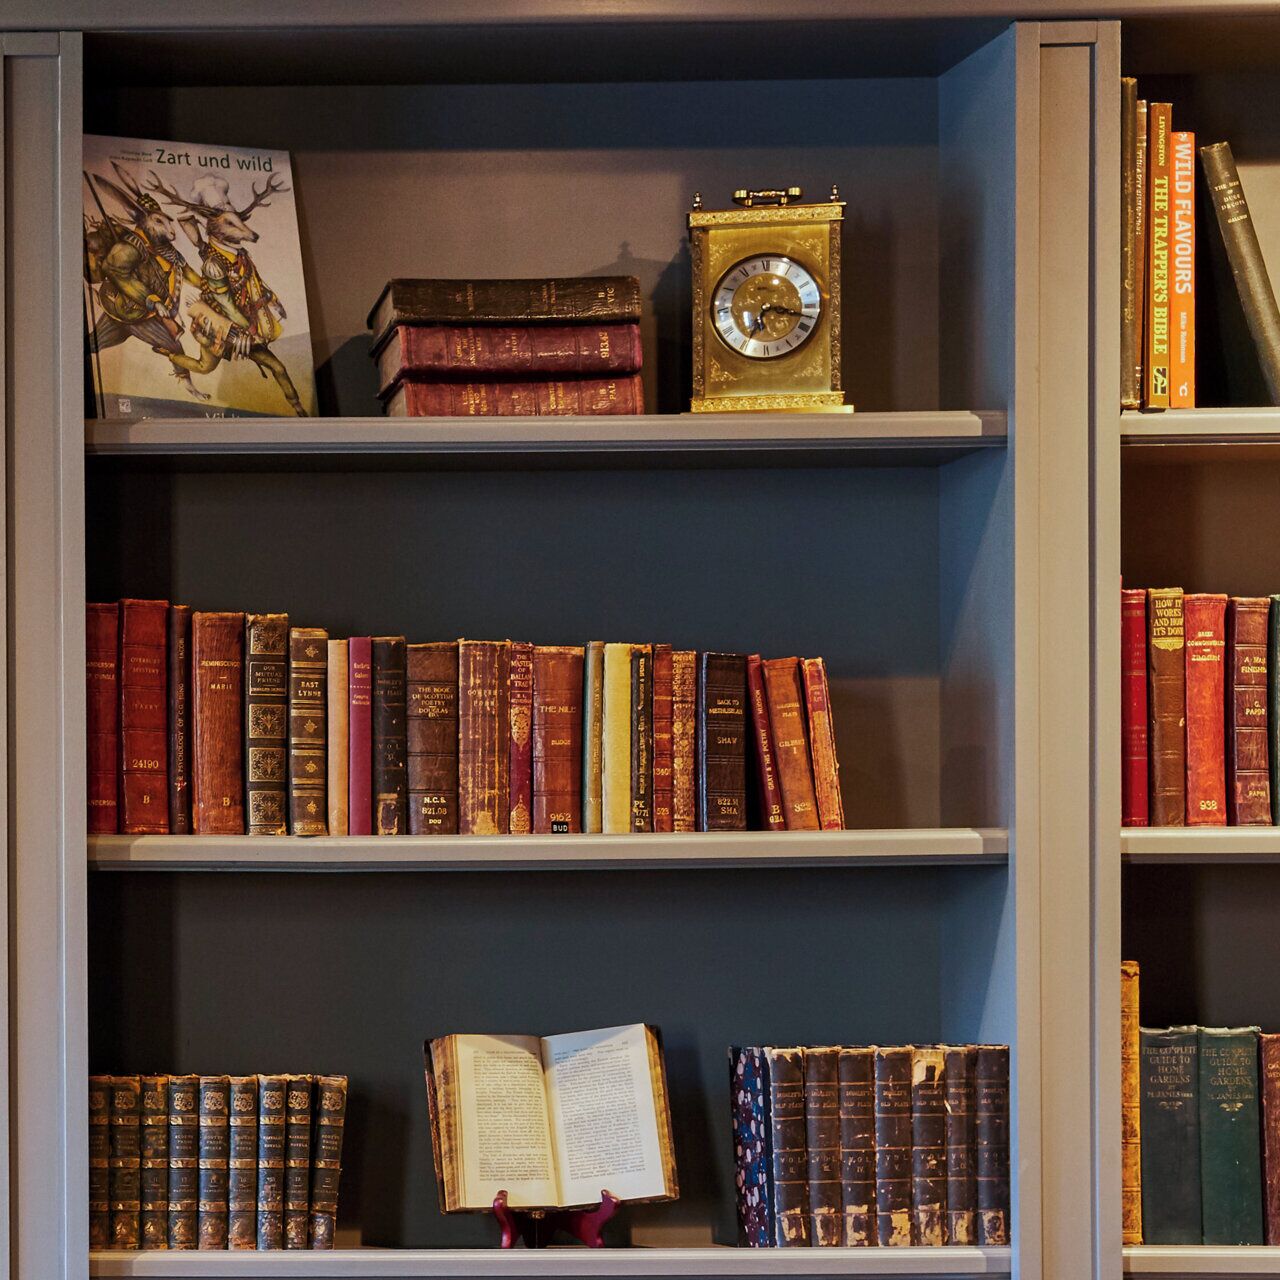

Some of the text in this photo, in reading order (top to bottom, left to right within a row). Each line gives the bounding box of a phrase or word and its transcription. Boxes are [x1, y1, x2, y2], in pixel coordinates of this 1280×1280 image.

[155, 149, 191, 165] Zart
[198, 154, 230, 169] und
[237, 157, 272, 172] wild
[1174, 143, 1192, 295] WILD FLAVOURS
[1153, 176, 1168, 354] THE TRAPPER'S BIBLE
[1155, 599, 1182, 608] HOW IT
[1156, 608, 1182, 616] WORKS
[300, 681, 318, 689] EAST
[717, 737, 738, 745] SHAW
[132, 759, 159, 770] 24190
[721, 807, 738, 815] SHA
[552, 823, 568, 832] BUD
